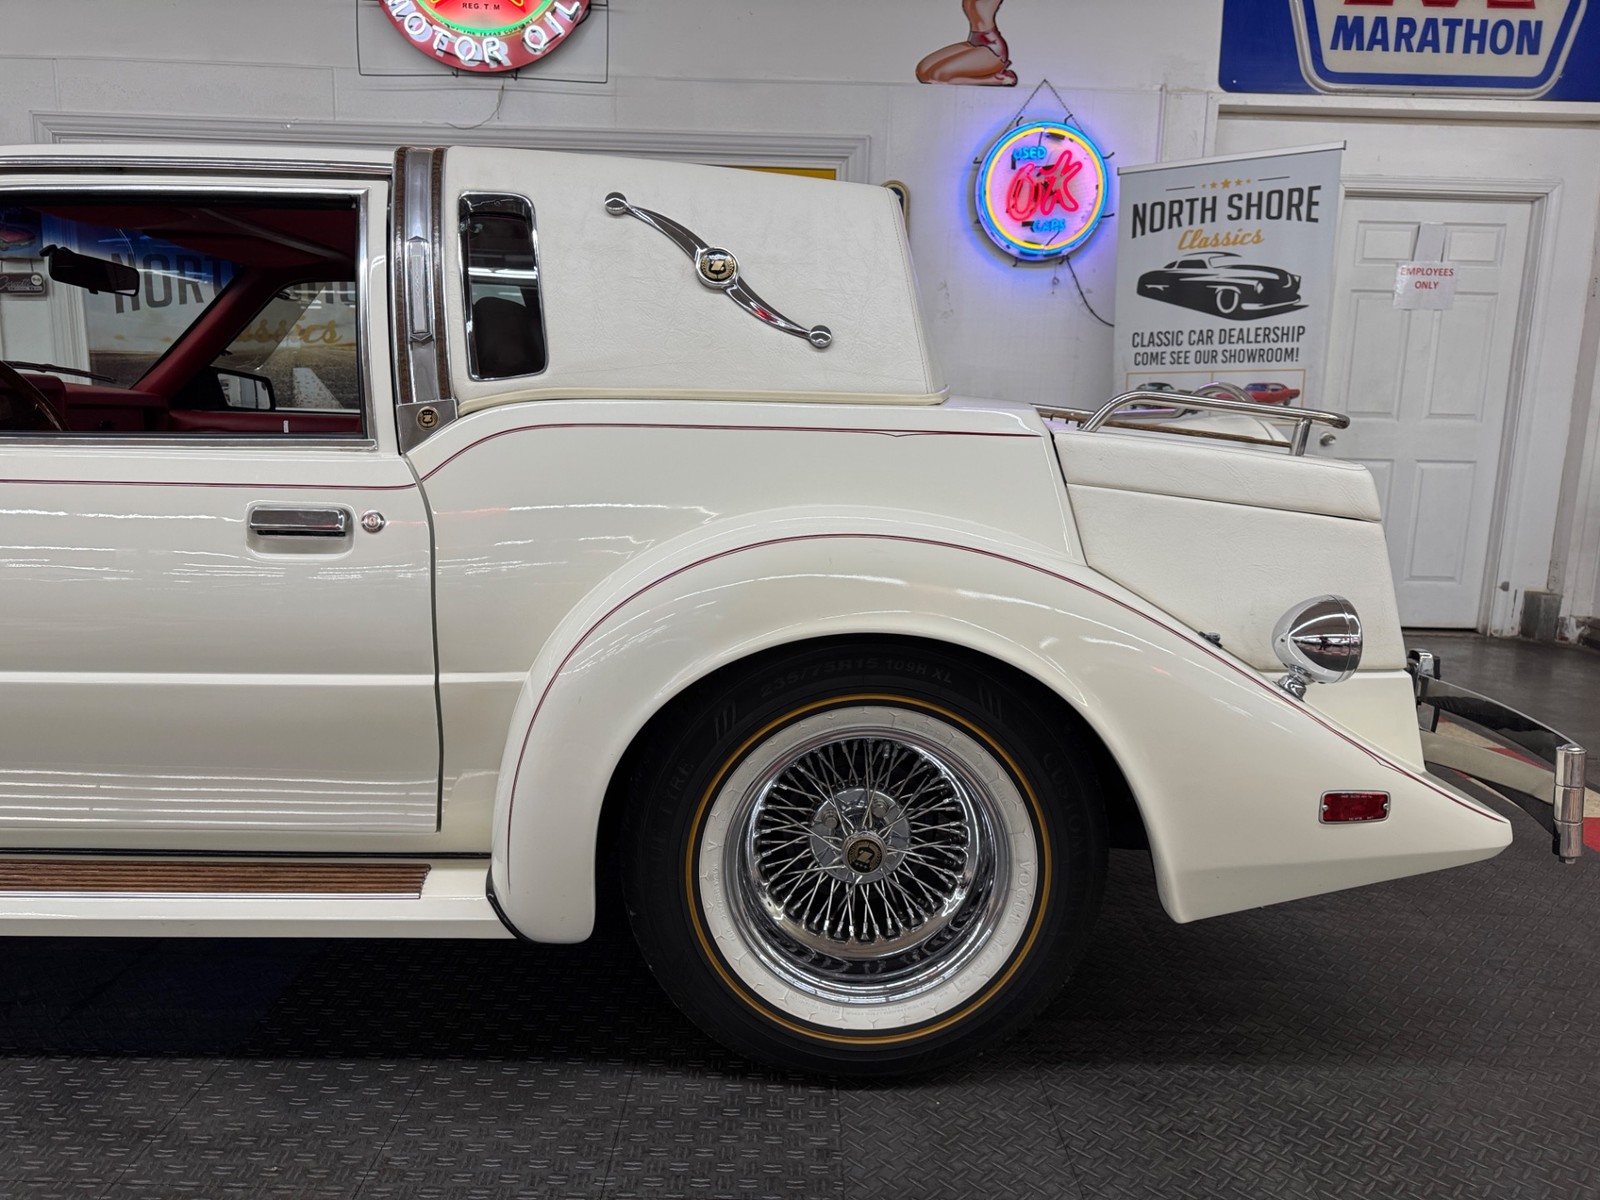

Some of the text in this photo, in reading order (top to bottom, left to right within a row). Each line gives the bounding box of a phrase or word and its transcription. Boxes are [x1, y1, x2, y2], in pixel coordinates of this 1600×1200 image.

[522, 1, 582, 55] OIL
[1330, 15, 1543, 56] MARATHON
[1012, 145, 1048, 160] USED
[1131, 185, 1322, 239] NORTH SHORE
[1032, 218, 1066, 233] CARS
[1177, 228, 1265, 251] Classics
[1401, 267, 1455, 277] EMPLOYEES
[1414, 280, 1440, 290] ONLY
[1132, 325, 1306, 348] CLASSIC CAR DEALERSHIP
[1134, 347, 1299, 366] COME SEE OUR SHOWROOM!
[884, 658, 928, 676] 109H
[930, 667, 956, 685] XL
[1040, 752, 1086, 857] CUSTOM
